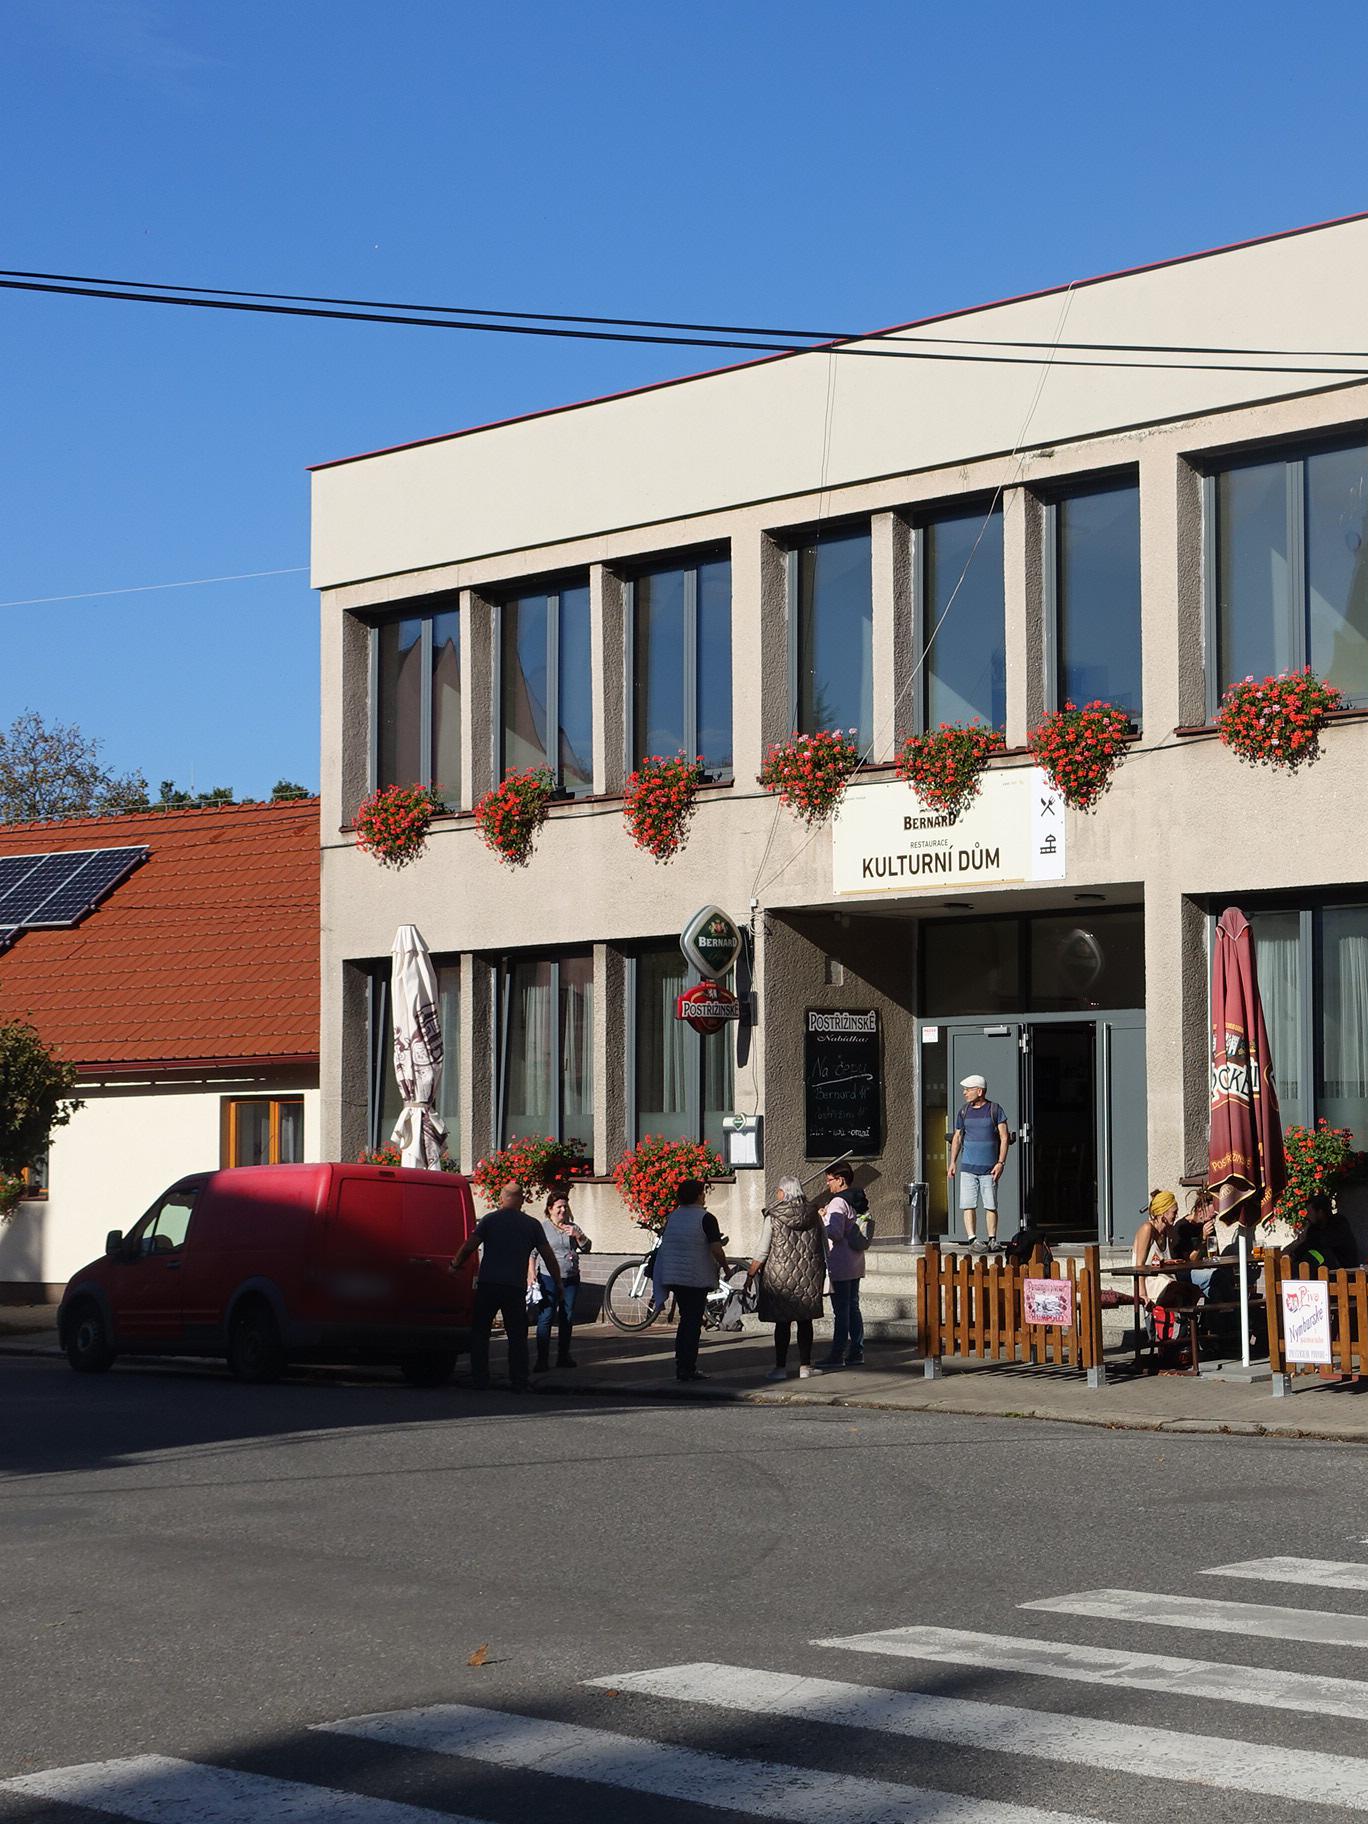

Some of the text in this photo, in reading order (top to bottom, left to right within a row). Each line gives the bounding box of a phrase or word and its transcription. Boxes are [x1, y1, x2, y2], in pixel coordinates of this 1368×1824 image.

[903, 812, 956, 831] BERNARD
[910, 839, 949, 848] RESTAURACE
[862, 842, 1001, 878] KULTURNÍ DŮM
[698, 936, 738, 947] BERNARD
[809, 1010, 876, 1031] POSTŘIŽINSKÉ
[1298, 1285, 1320, 1311] Pivo
